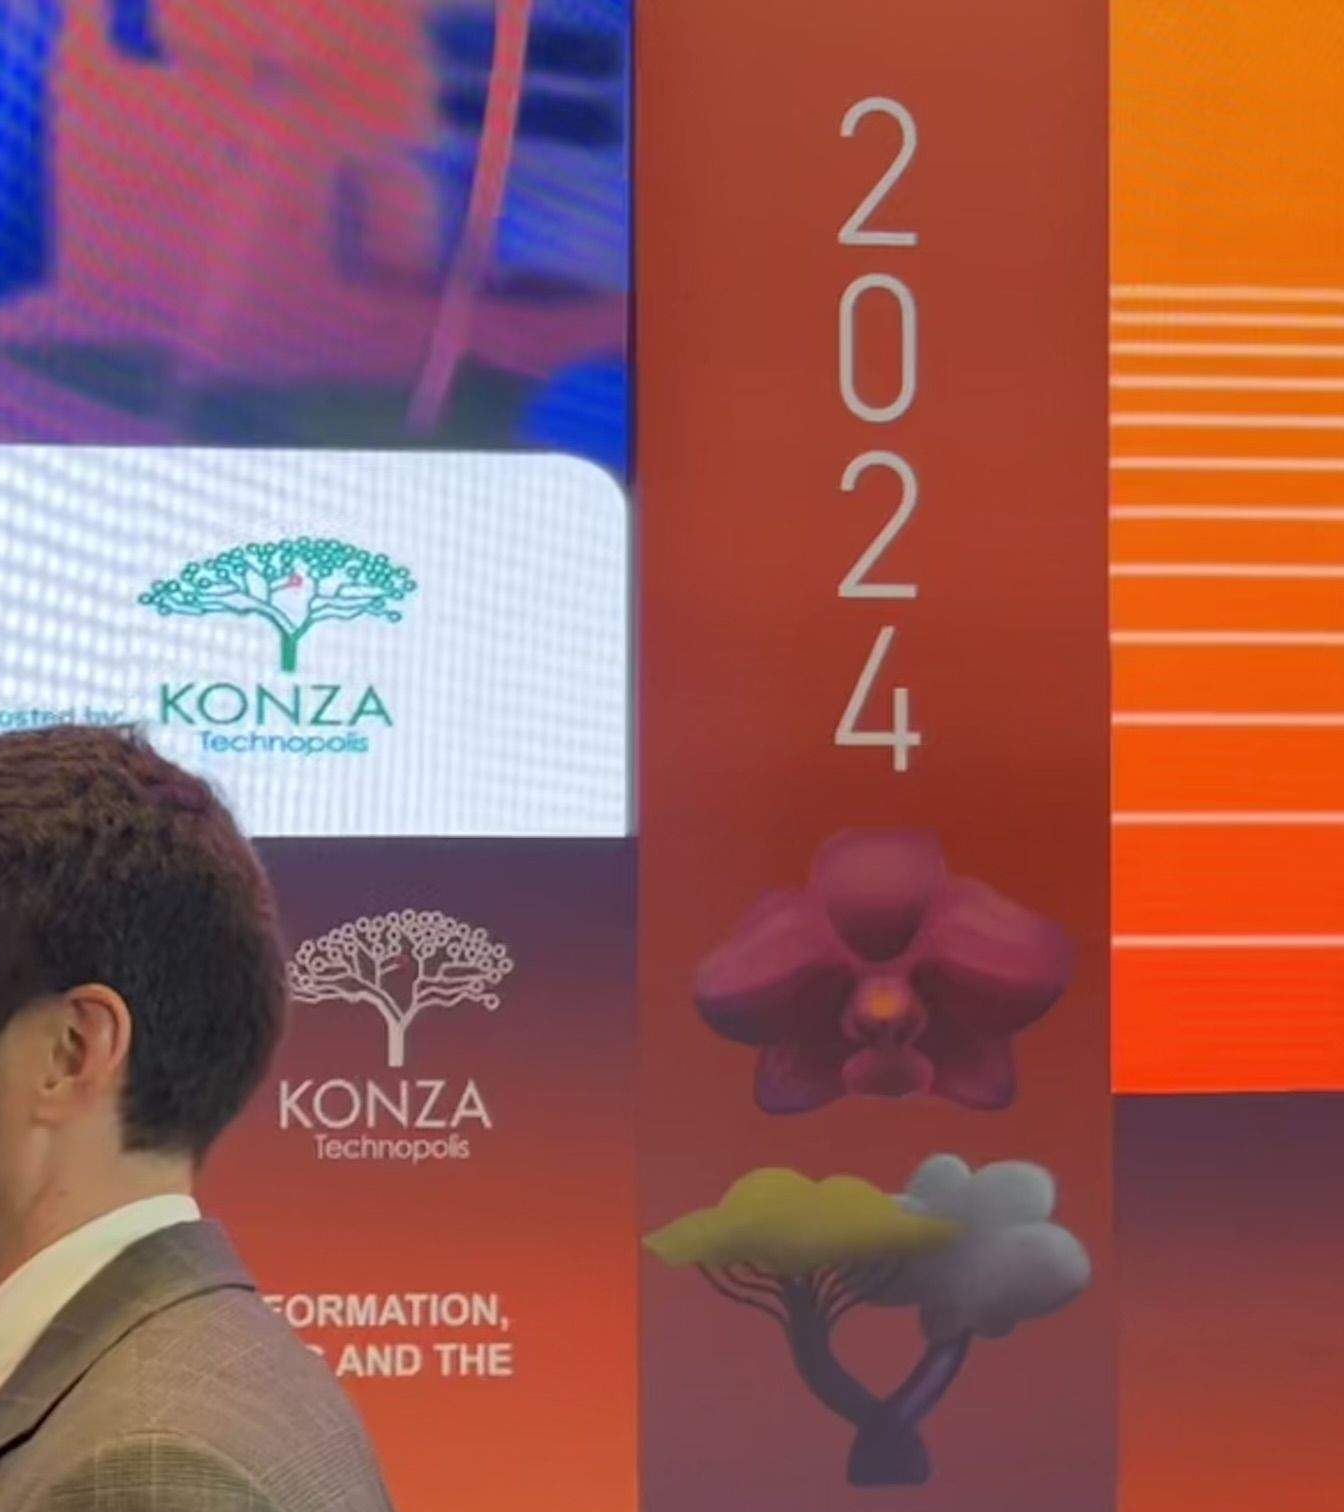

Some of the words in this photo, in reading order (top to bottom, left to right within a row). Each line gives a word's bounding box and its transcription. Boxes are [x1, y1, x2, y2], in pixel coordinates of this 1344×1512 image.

[835, 96, 921, 771] 2024
[160, 682, 394, 728] KONZA
[199, 731, 370, 756] Technopolis
[279, 1078, 492, 1130] KONZA
[313, 1133, 471, 1165] Technopolis
[334, 1343, 422, 1377] AND
[433, 1342, 514, 1377] THE
